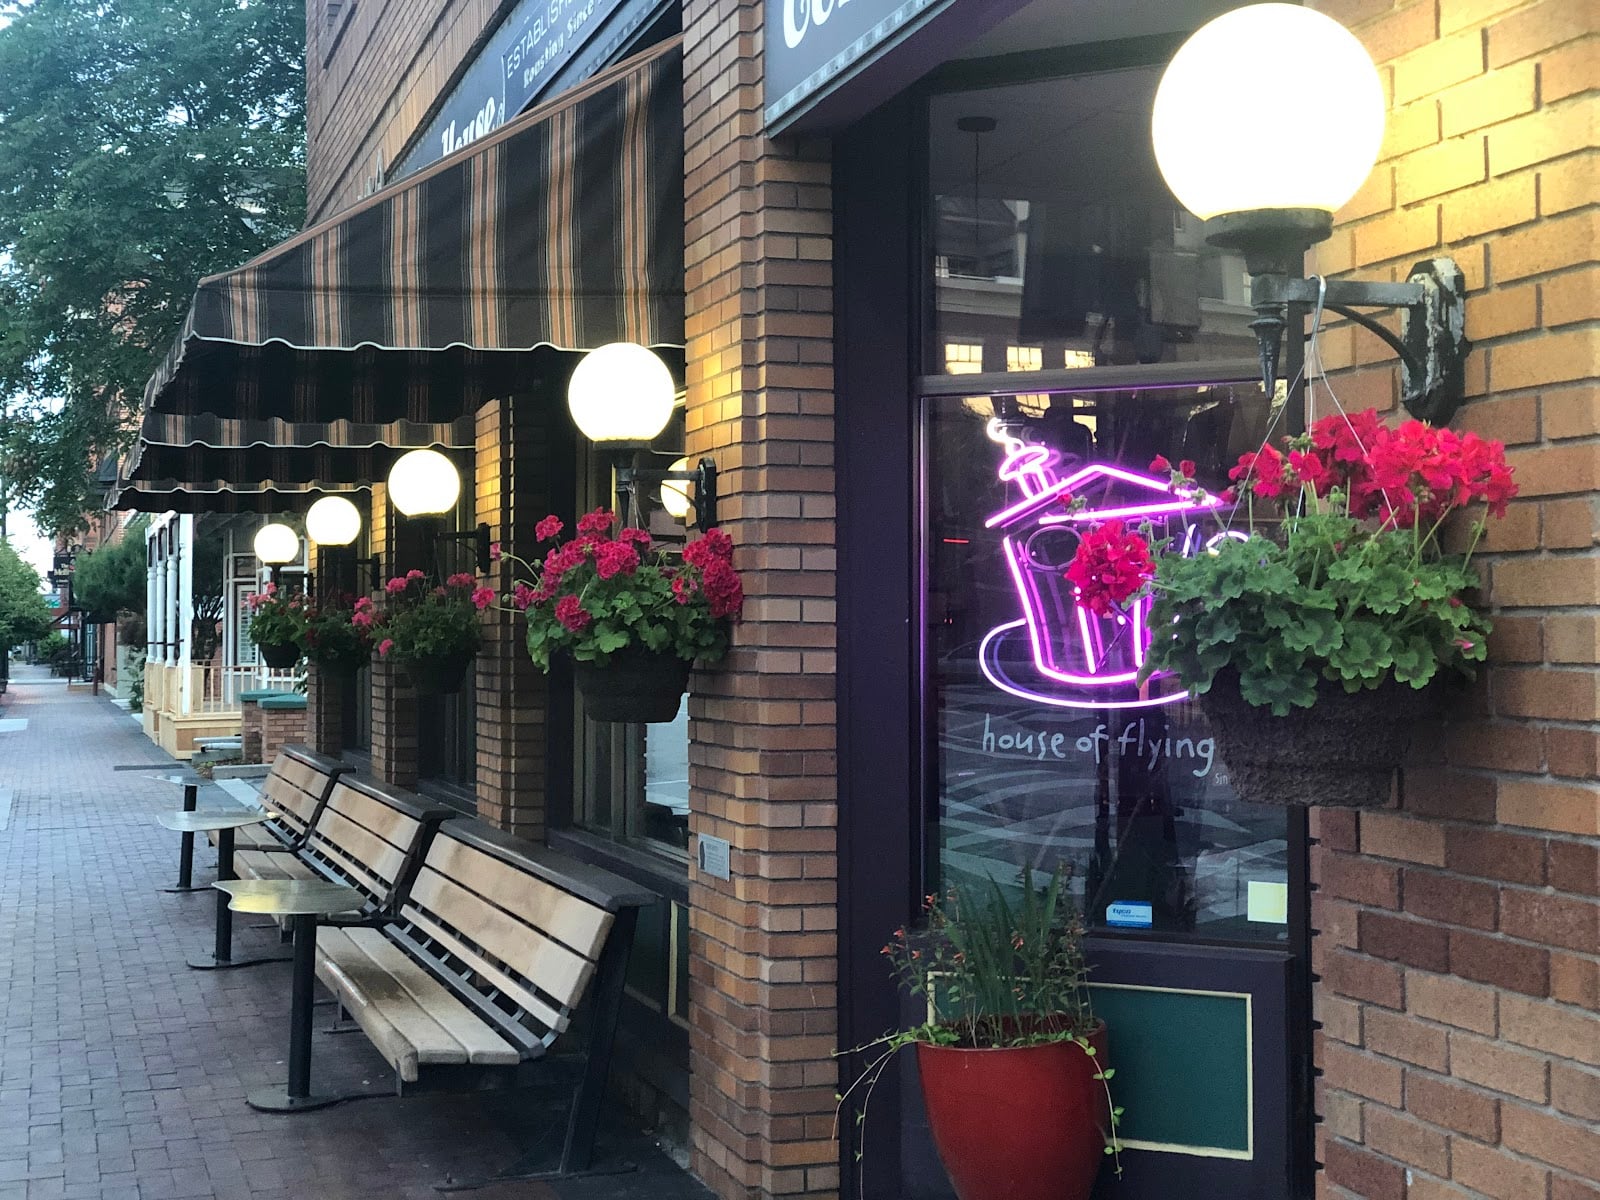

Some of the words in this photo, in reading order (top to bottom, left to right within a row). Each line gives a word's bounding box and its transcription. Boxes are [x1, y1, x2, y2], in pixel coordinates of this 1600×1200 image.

[507, 0, 572, 79] ESTABLISH
[983, 713, 1065, 760] house
[1076, 724, 1109, 764] of
[1117, 717, 1215, 777] flying
